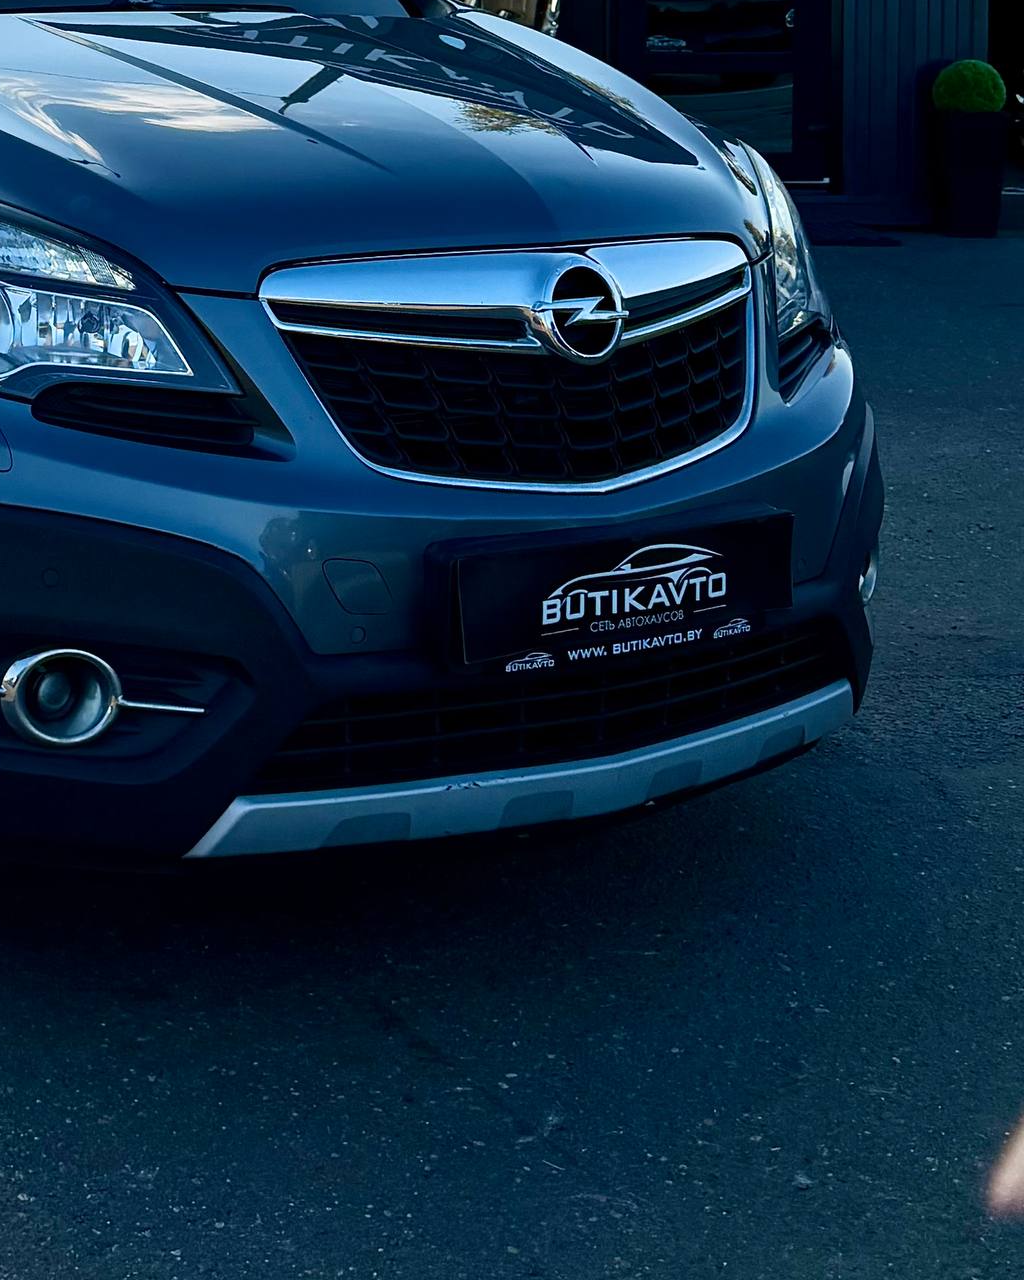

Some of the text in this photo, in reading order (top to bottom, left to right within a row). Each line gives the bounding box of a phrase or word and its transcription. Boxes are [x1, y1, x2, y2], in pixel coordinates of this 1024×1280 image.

[542, 572, 727, 626] BUTIKAVTO
[589, 609, 684, 632] СЕТЬ АВТОХАУСОВ
[567, 628, 703, 661] WWW. BUTIKAVTO.BY
